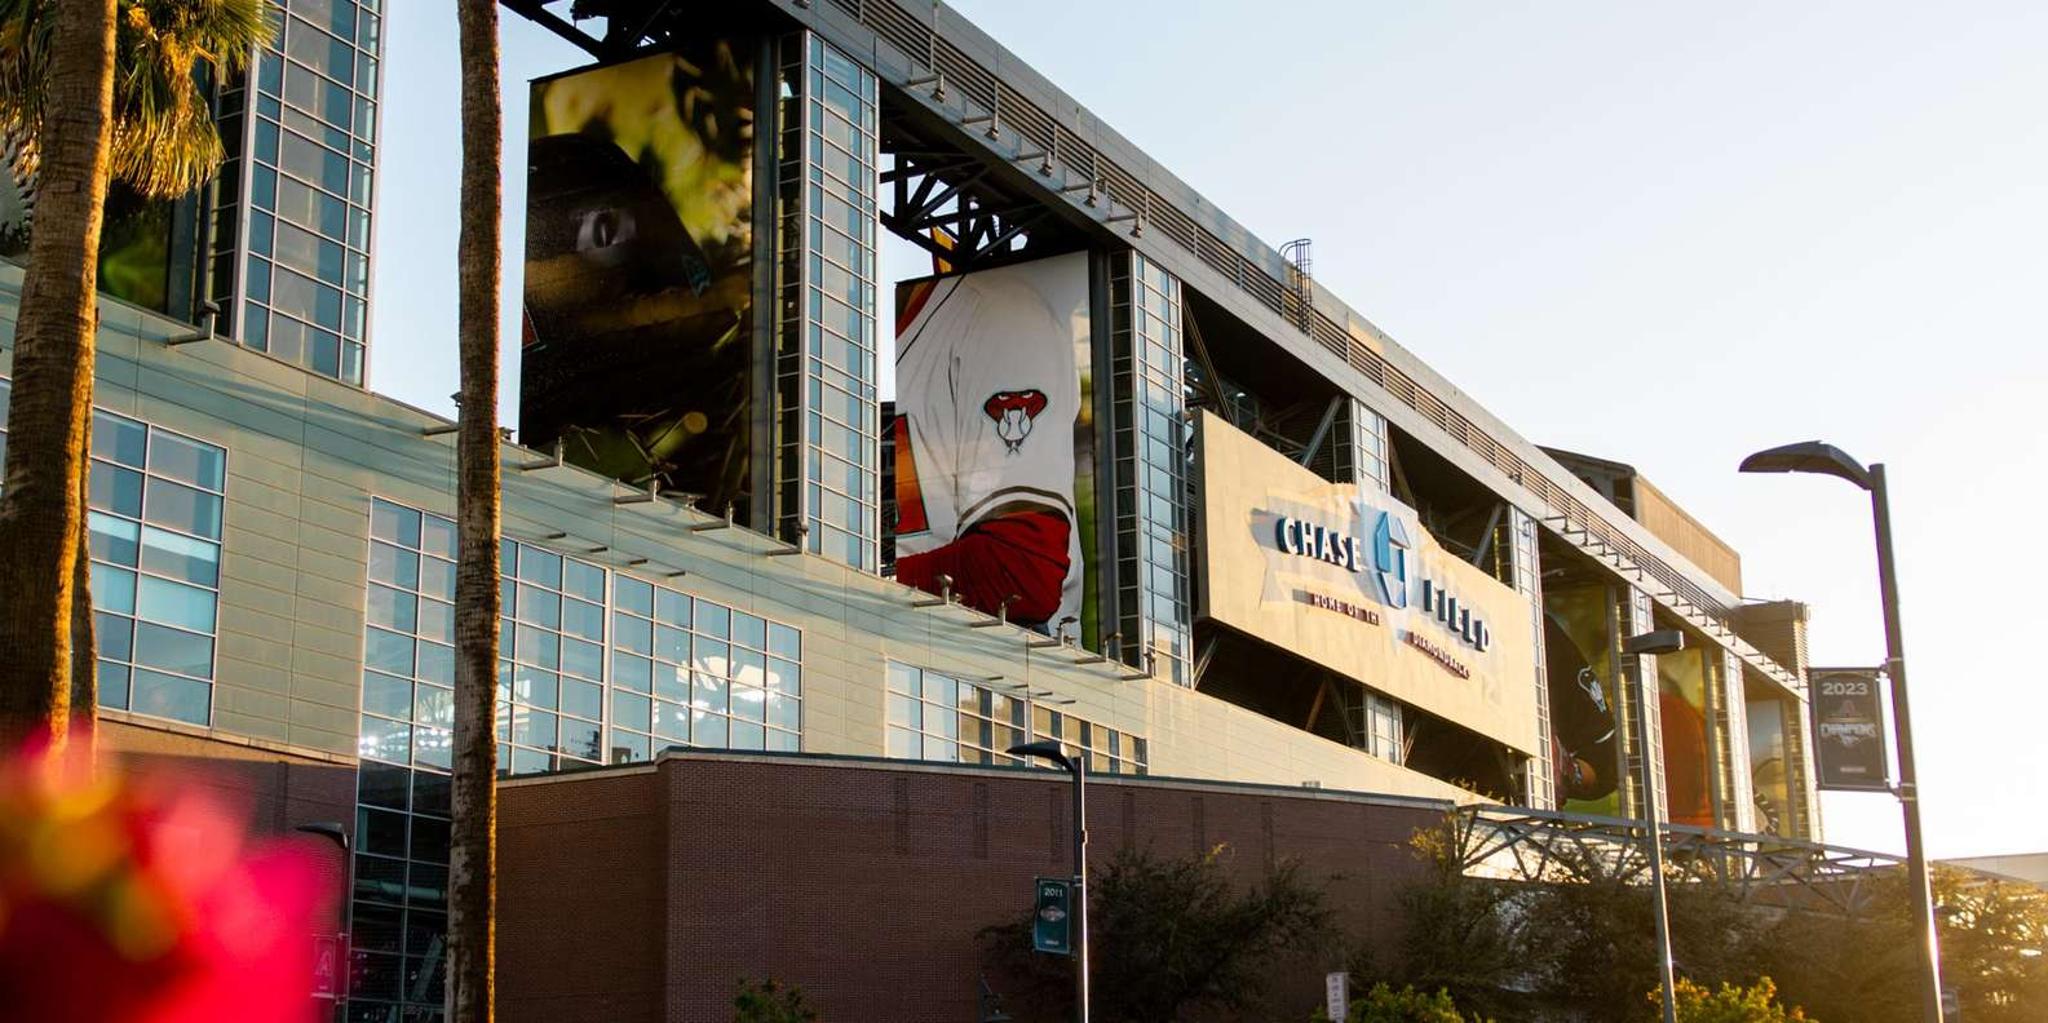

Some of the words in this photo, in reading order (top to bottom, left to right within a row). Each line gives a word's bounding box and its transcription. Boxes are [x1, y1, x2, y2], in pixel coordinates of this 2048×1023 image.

[1276, 517, 1364, 572] CHASE
[1311, 593, 1343, 613] HOME
[1423, 579, 1490, 653] FIELD
[1822, 683, 1868, 695] 2023
[1044, 887, 1063, 897] 2011
